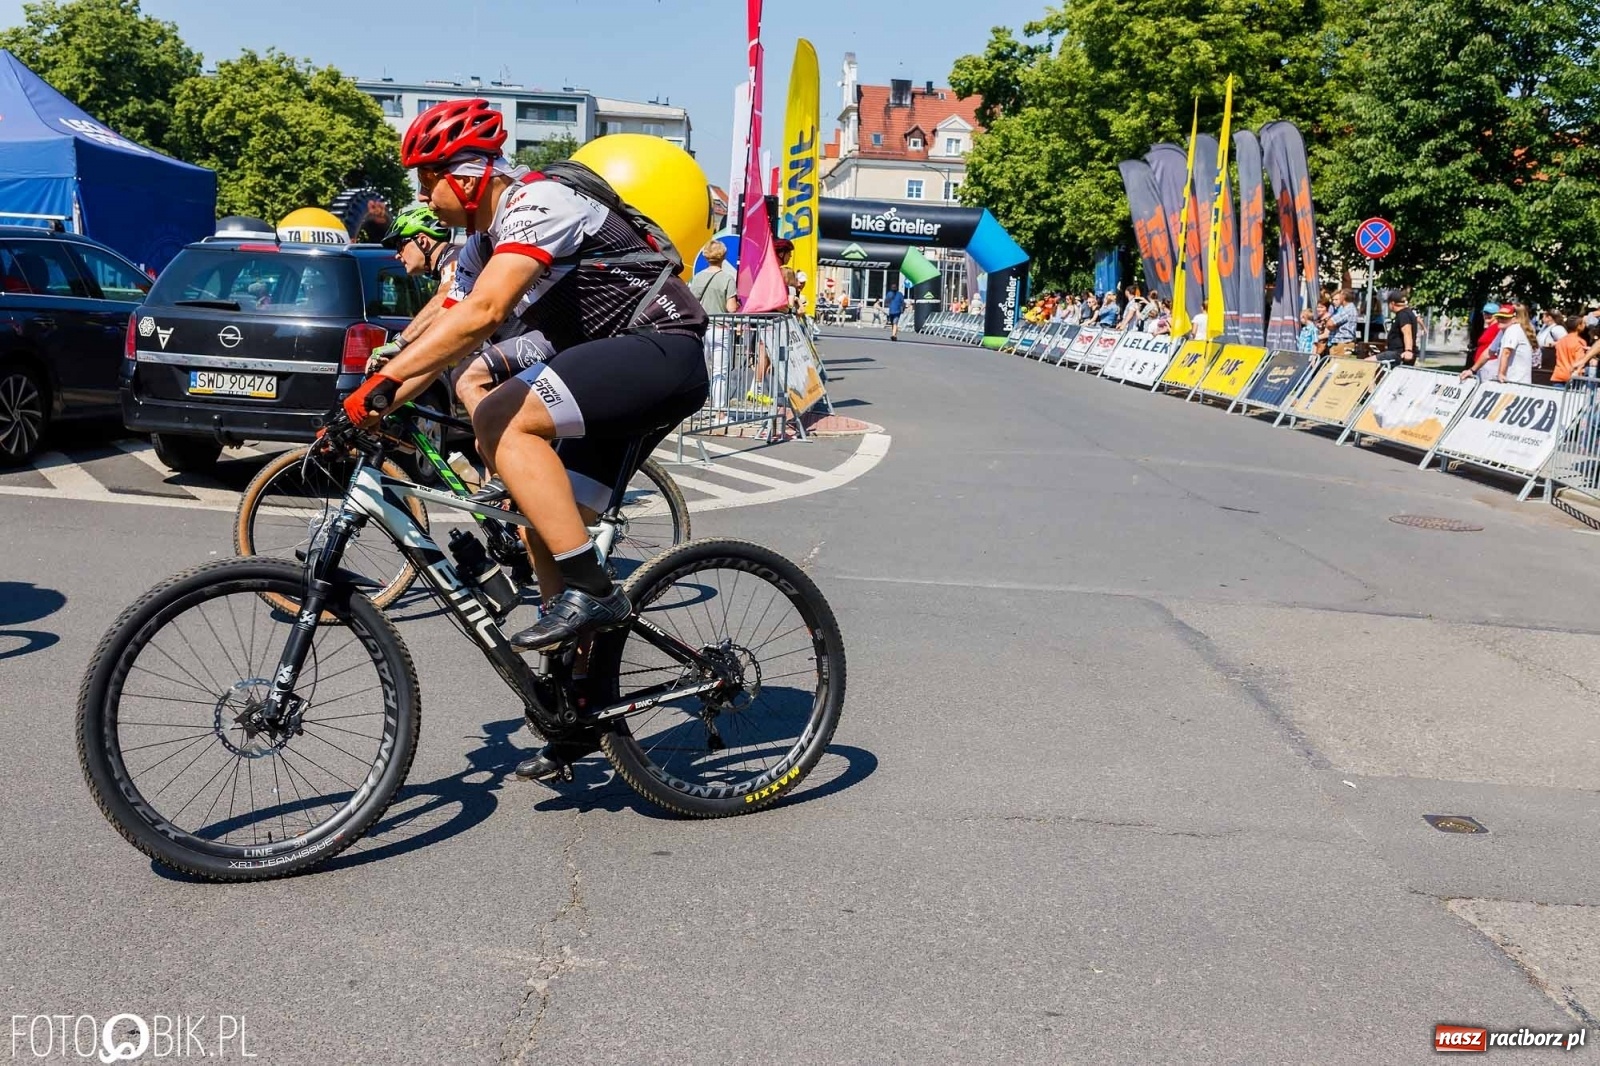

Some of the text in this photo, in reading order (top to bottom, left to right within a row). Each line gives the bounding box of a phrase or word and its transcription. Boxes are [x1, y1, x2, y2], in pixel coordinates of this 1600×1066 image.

[851, 213, 941, 235] bike atelier
[818, 257, 891, 269] MERIDA
[656, 294, 682, 322] bike
[1003, 275, 1017, 332] bike atelier
[198, 373, 225, 389] SWD
[229, 374, 274, 393] 90476
[347, 616, 399, 815] BONTRAGE
[646, 722, 817, 800] BONTRAGER
[744, 765, 802, 804] MAXXIS
[243, 847, 273, 858] LINE
